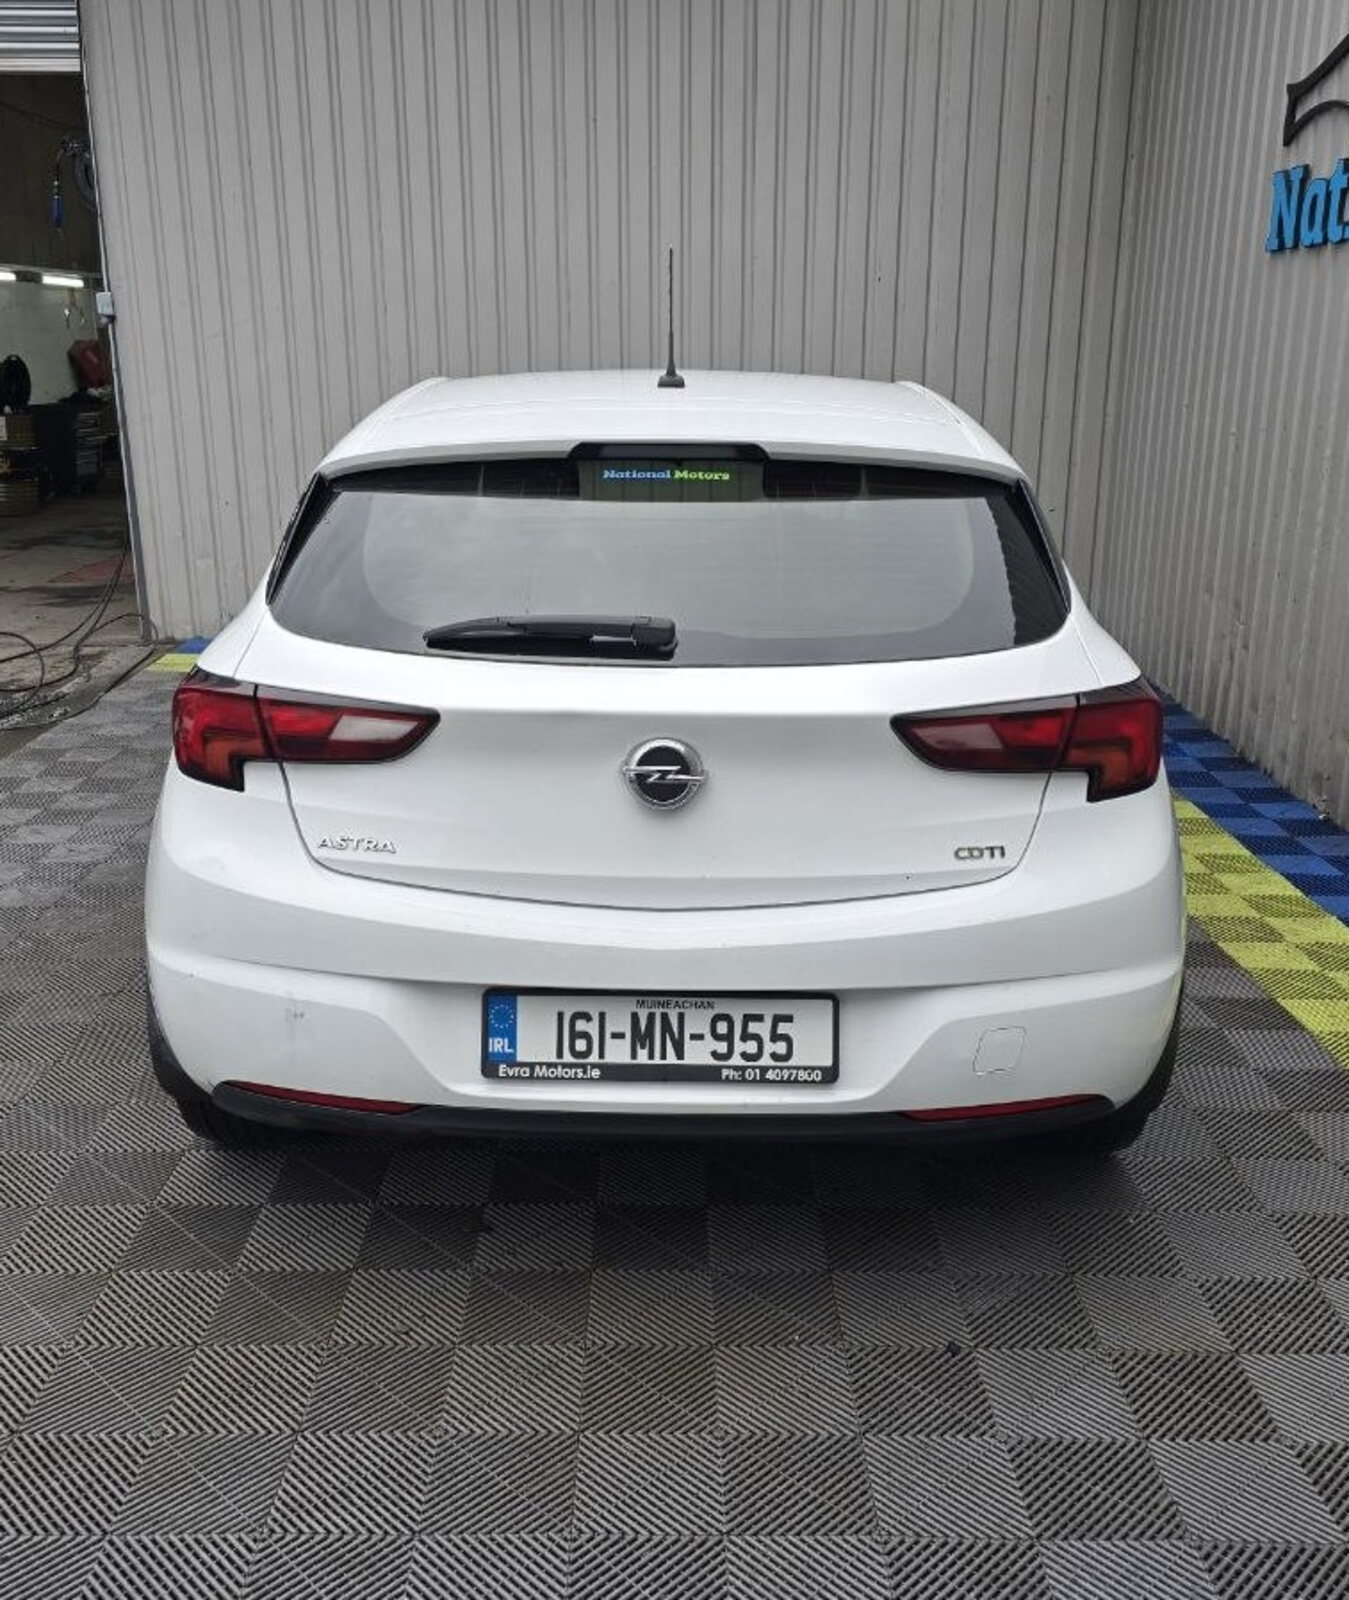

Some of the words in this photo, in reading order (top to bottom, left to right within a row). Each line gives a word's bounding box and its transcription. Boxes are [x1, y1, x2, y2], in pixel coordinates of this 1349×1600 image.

[1265, 157, 1349, 253] Nat
[603, 470, 671, 479] National
[674, 470, 730, 480] Motors
[317, 836, 396, 854] ASTRA
[954, 845, 1005, 859] CDTI
[635, 998, 715, 1010] MUINEACHAN
[556, 1010, 794, 1063] 161-MN-955
[488, 1037, 513, 1053] IRL
[498, 1064, 530, 1078] Evra
[534, 1064, 601, 1079] Motors.ie
[721, 1068, 742, 1080] Ph:
[745, 1069, 761, 1081] 01
